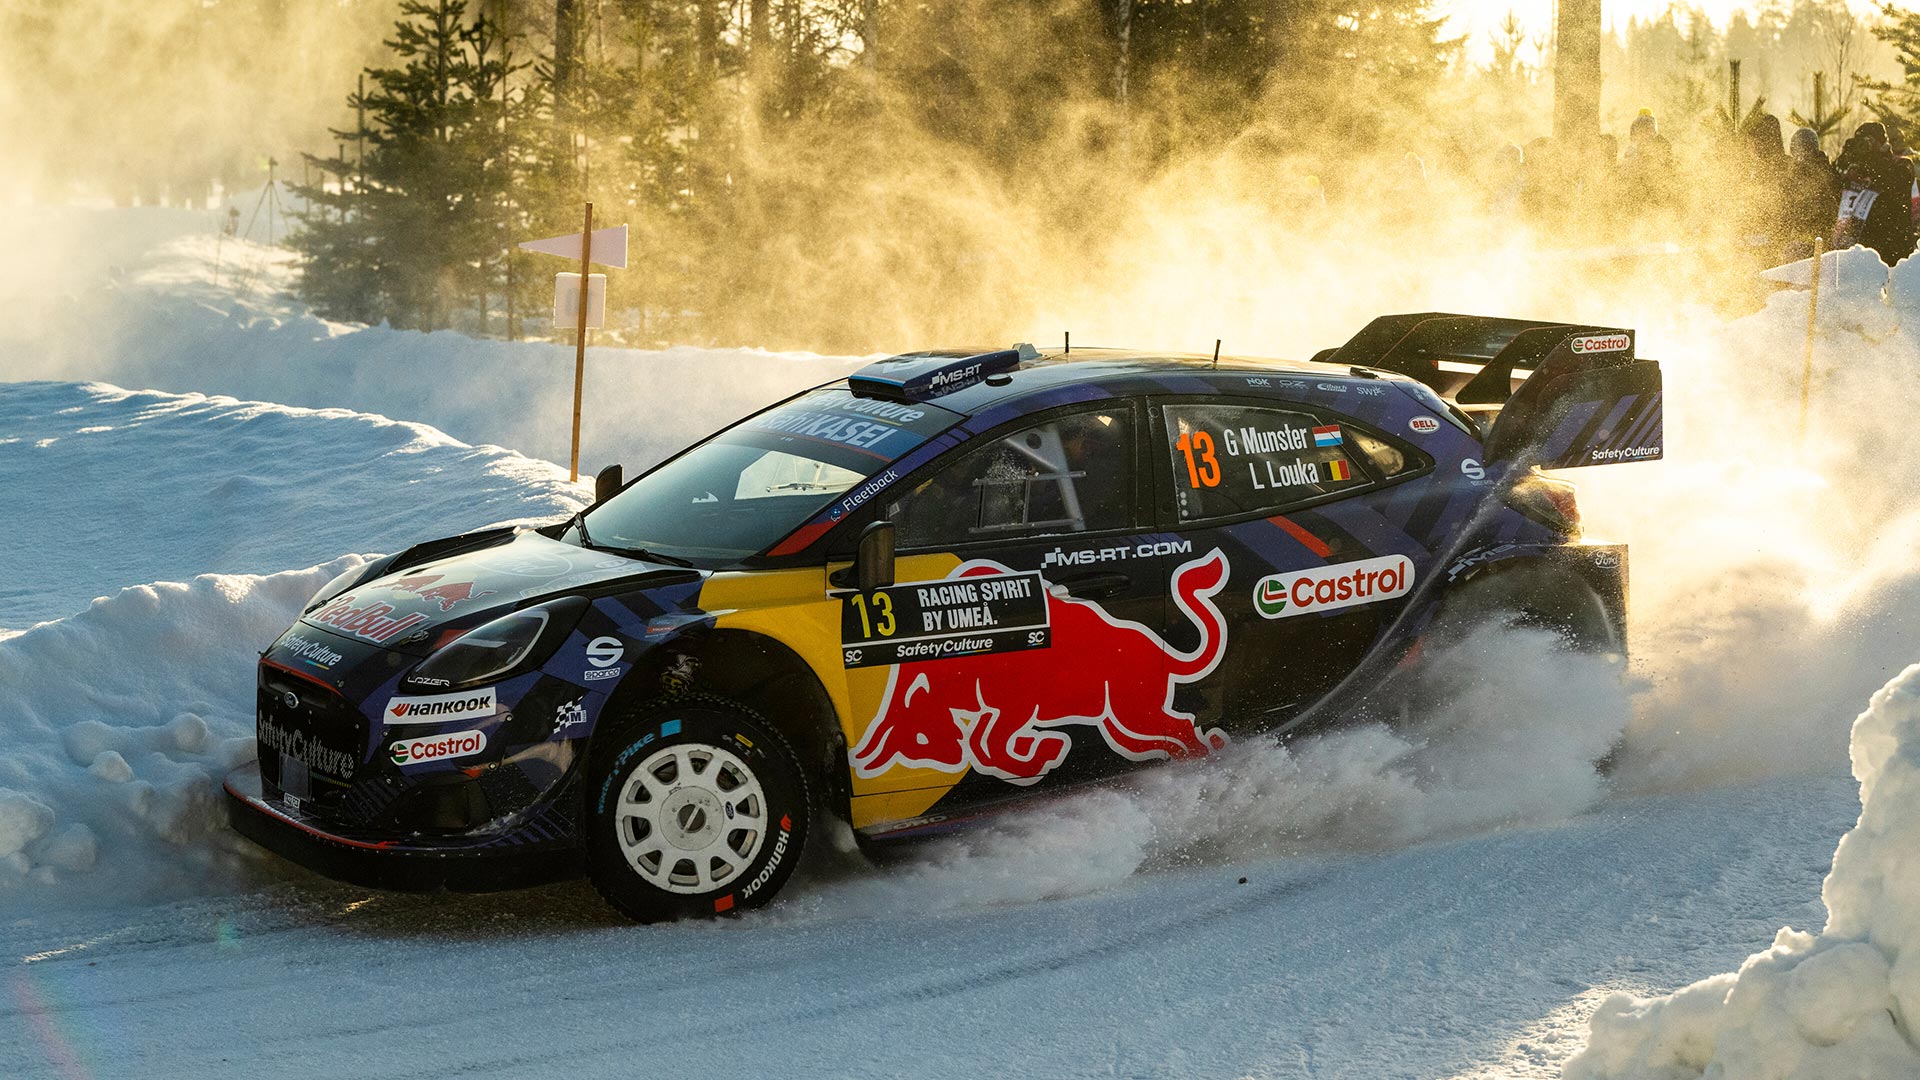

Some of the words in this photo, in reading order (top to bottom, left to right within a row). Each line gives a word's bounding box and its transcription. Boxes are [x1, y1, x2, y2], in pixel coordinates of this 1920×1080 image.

[1585, 338, 1627, 350] Castrol
[940, 363, 982, 386] MS-RT
[1246, 378, 1270, 386] NGK
[1412, 419, 1437, 429] BELL
[1223, 428, 1240, 457] G
[1243, 424, 1308, 455] Munster
[1592, 446, 1660, 461] SafetyCulture
[1176, 431, 1222, 489] 13
[1249, 462, 1265, 490] L
[1266, 458, 1320, 489] Louka
[842, 469, 899, 512] Fleetback
[917, 583, 978, 608] RACING
[981, 578, 1033, 602] SPIRIT
[1291, 561, 1405, 609] Castrol
[851, 591, 897, 639] 13
[922, 610, 945, 632] BY
[947, 601, 999, 629] UMEÅ.
[281, 633, 343, 667] SafetyCulture
[896, 637, 994, 658] SafetyCulture
[1027, 631, 1045, 644] SC
[845, 649, 863, 663] SC
[585, 668, 620, 680] sparco
[411, 733, 481, 760] Castrol
